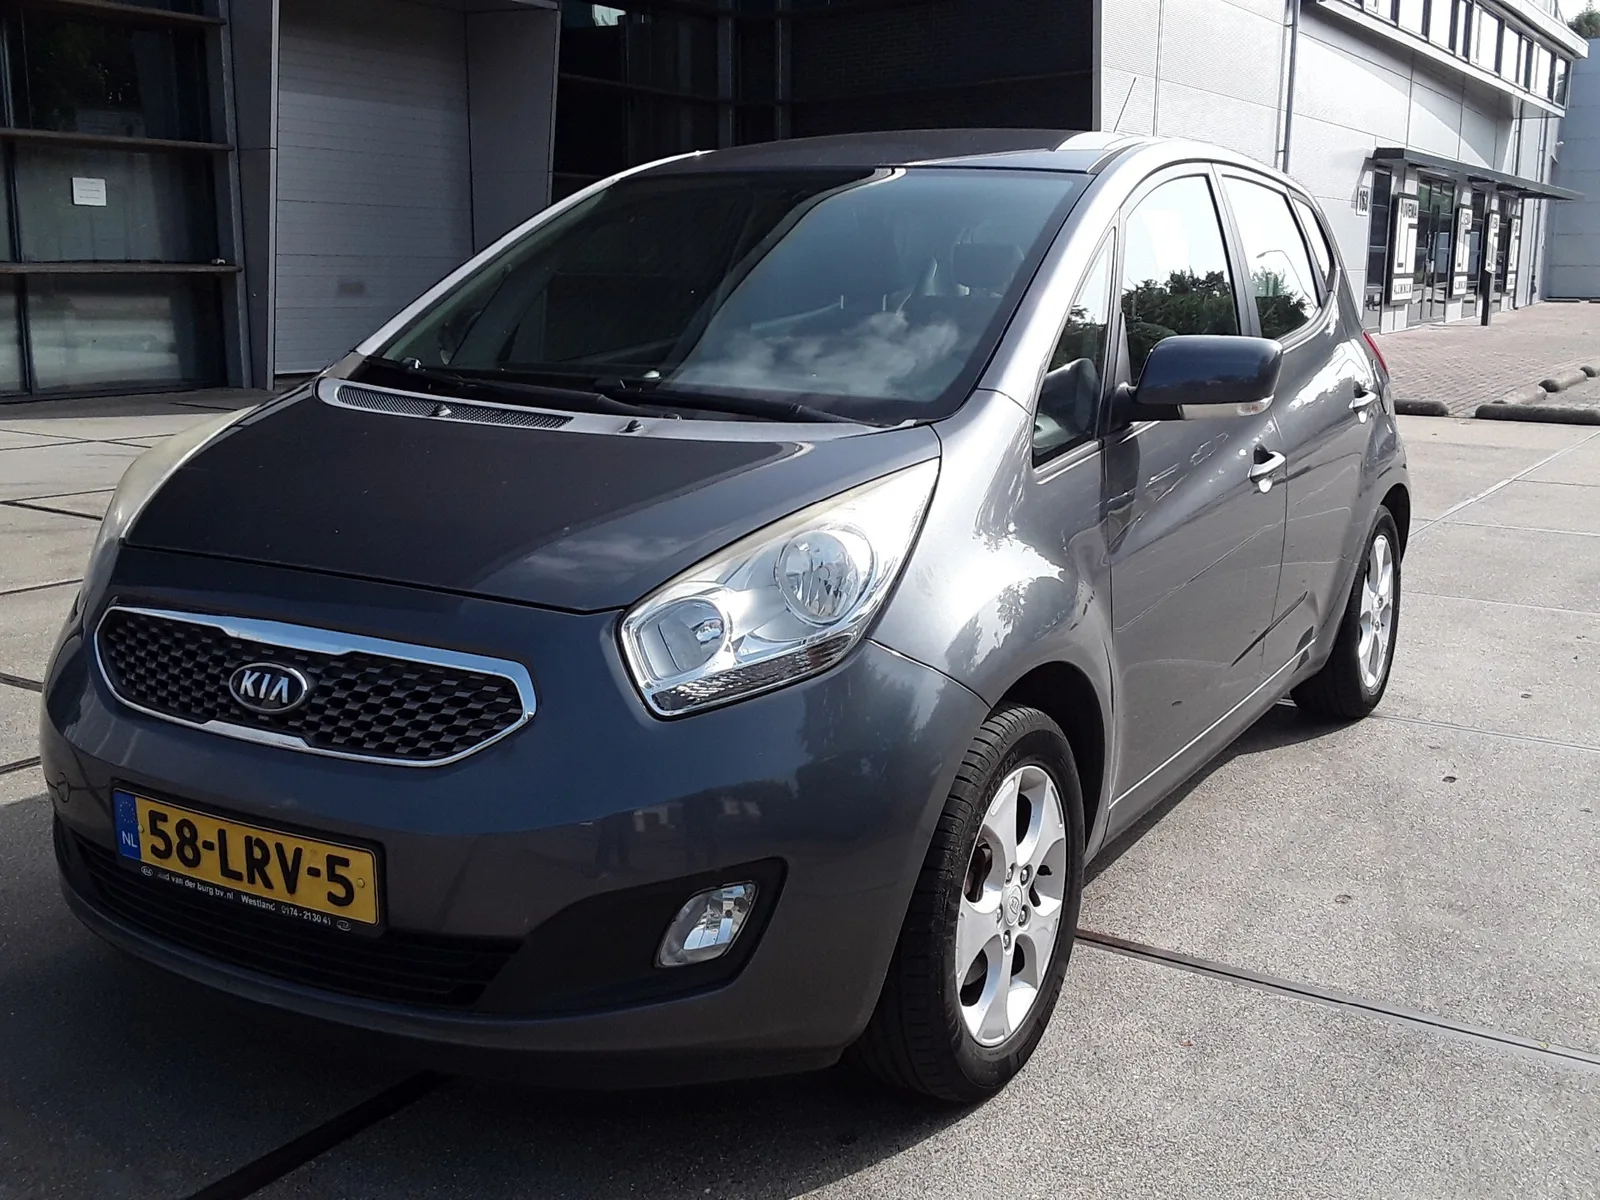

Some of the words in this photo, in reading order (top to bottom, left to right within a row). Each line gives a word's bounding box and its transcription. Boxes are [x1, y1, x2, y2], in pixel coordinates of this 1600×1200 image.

[239, 669, 290, 704] KIA
[121, 830, 138, 848] NL
[147, 809, 355, 907] 58-LRV-5
[171, 877, 184, 885] van
[184, 880, 196, 888] der
[197, 882, 214, 896] burg
[241, 894, 276, 911] Westland
